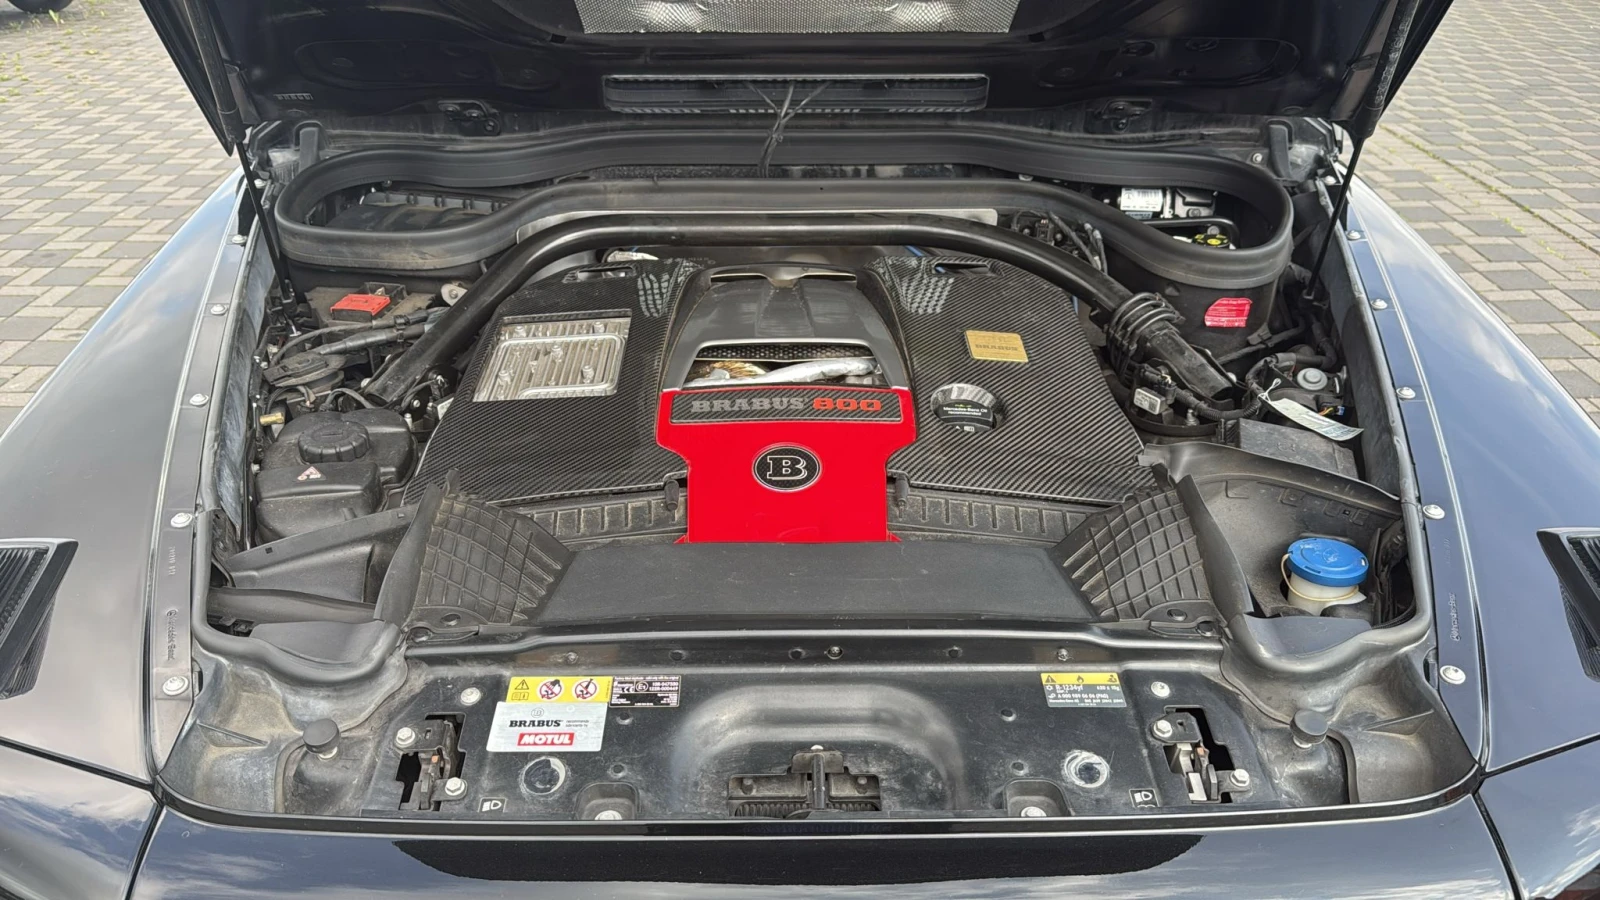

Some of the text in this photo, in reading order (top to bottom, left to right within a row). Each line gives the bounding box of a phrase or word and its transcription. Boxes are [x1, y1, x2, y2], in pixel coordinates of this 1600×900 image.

[690, 397, 882, 413] BRABUS 800
[766, 455, 808, 481] B
[508, 719, 561, 728] BRABUS
[520, 734, 571, 745] MOTUL
